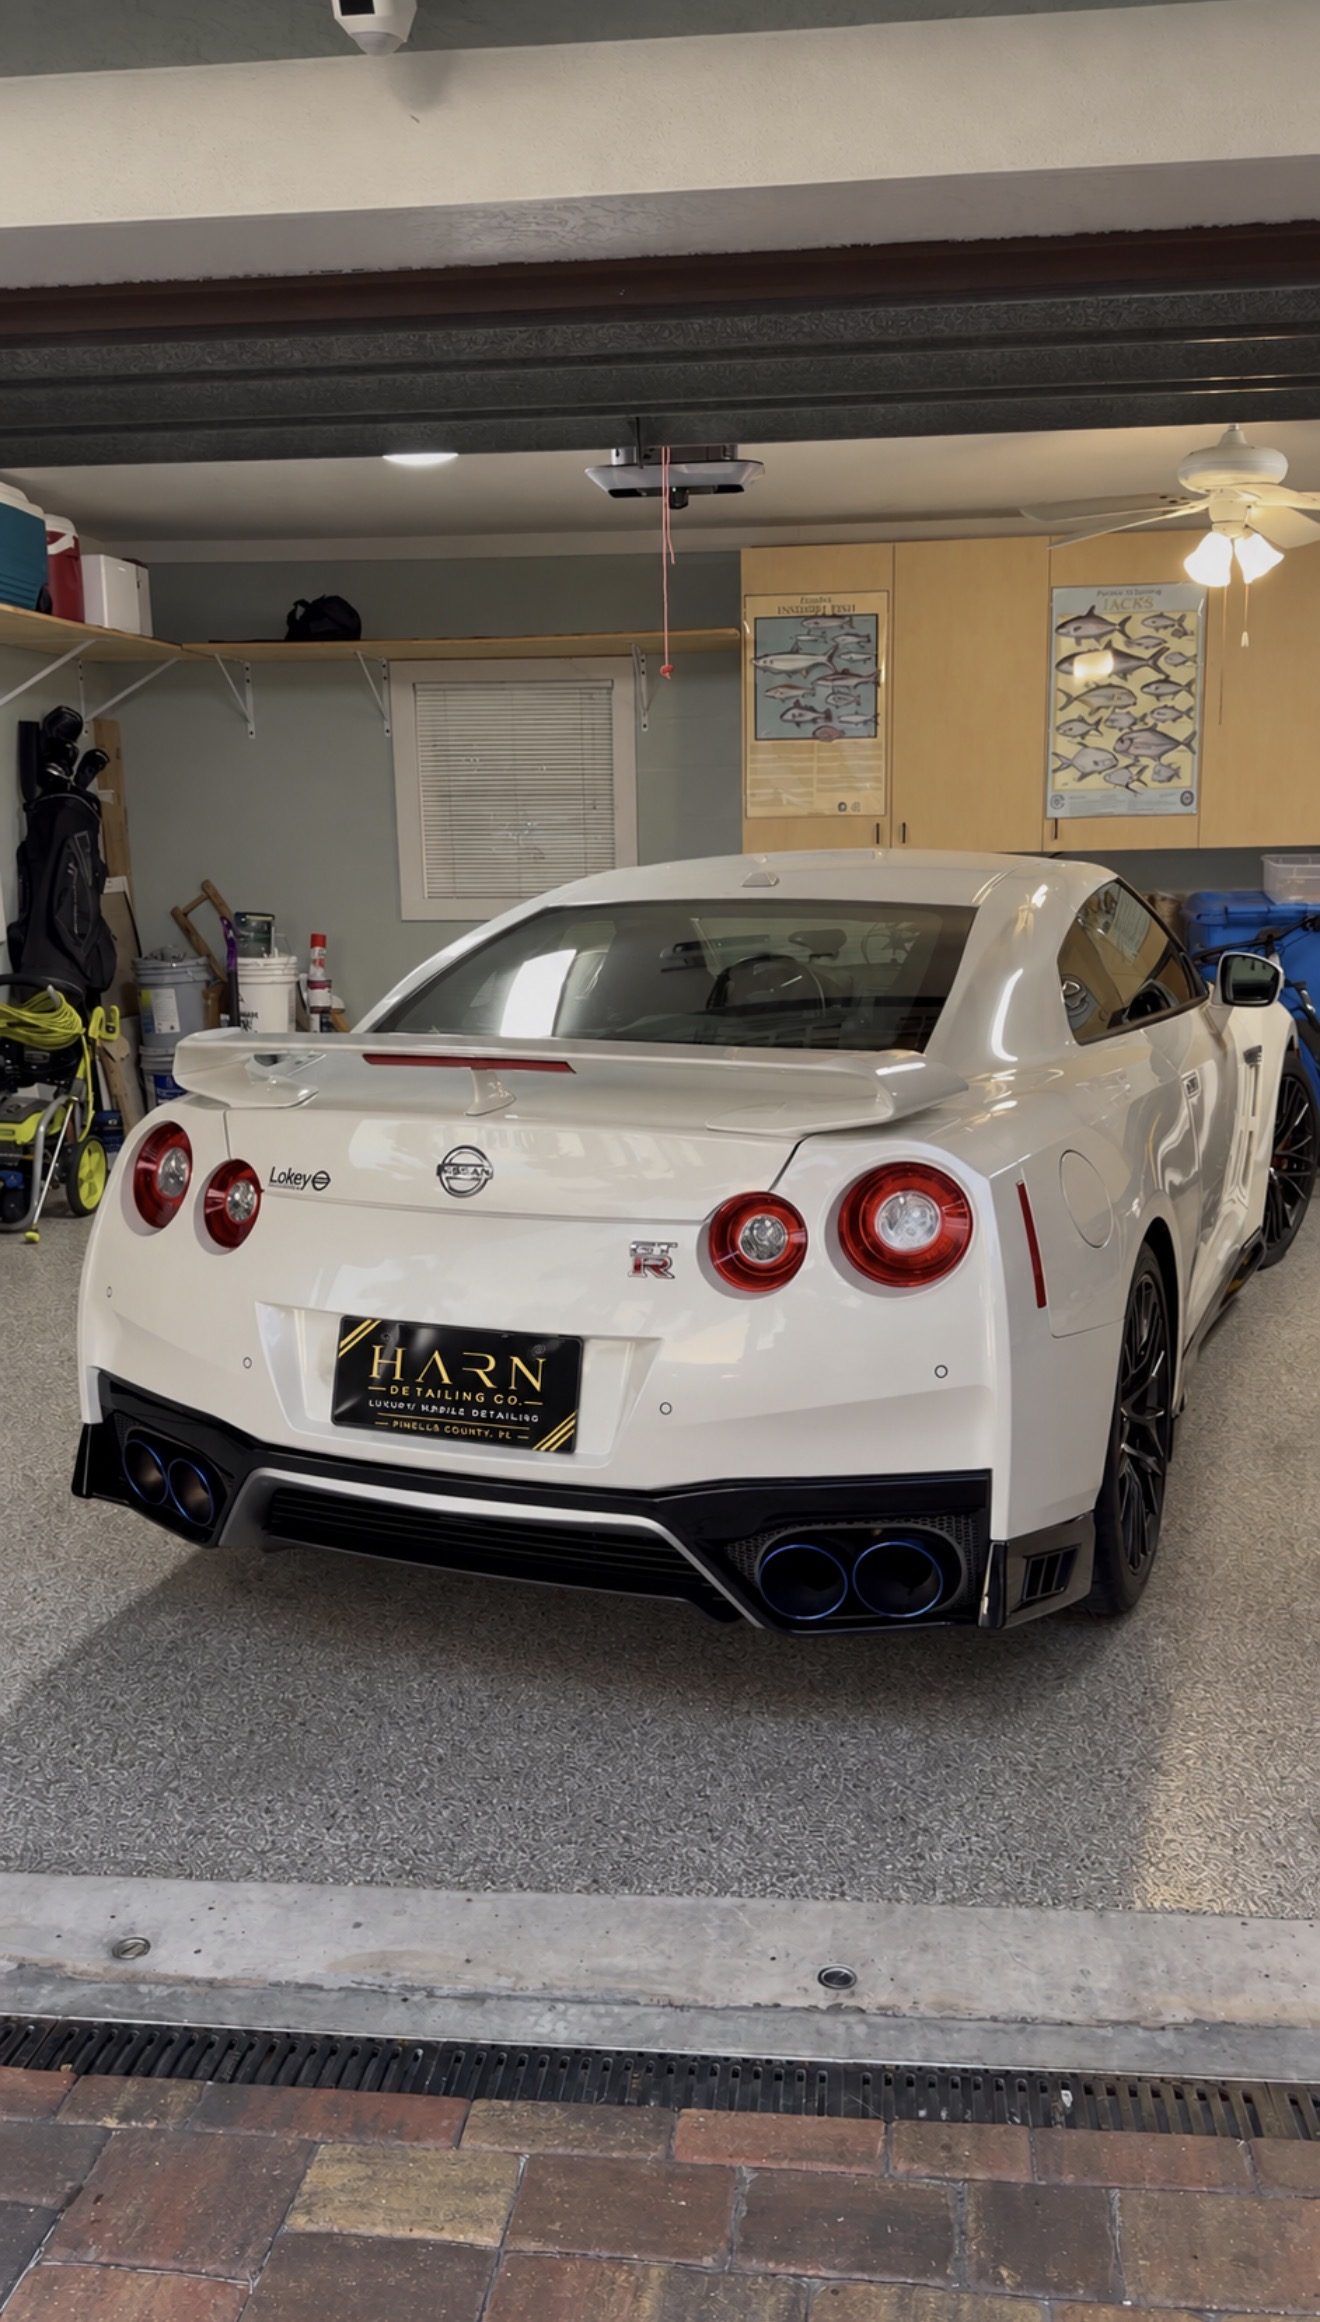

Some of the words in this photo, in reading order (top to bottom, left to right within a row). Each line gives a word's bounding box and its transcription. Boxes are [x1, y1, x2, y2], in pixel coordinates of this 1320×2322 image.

[269, 1166, 312, 1191] Lokey
[368, 1344, 546, 1393] HARN
[389, 1384, 485, 1404] DETAILING
[494, 1394, 523, 1407] CO.
